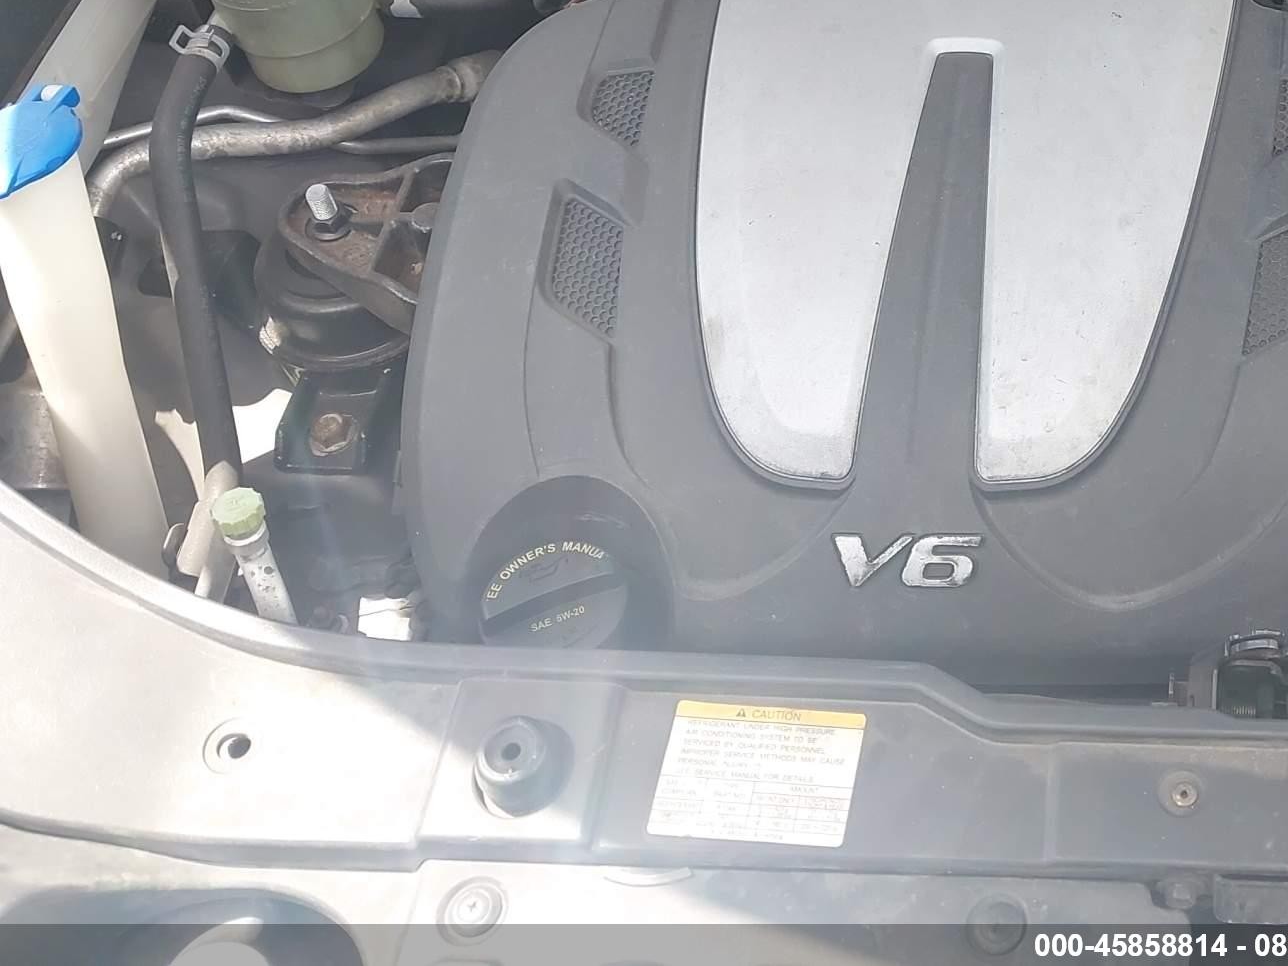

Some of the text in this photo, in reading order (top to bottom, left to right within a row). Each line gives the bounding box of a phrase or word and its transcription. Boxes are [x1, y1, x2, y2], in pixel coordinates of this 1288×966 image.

[486, 583, 503, 602] EE
[500, 543, 556, 580] OWNER'S
[834, 535, 982, 587] V6
[530, 605, 586, 632] SAE 5W-20
[752, 708, 802, 721] CAUTION
